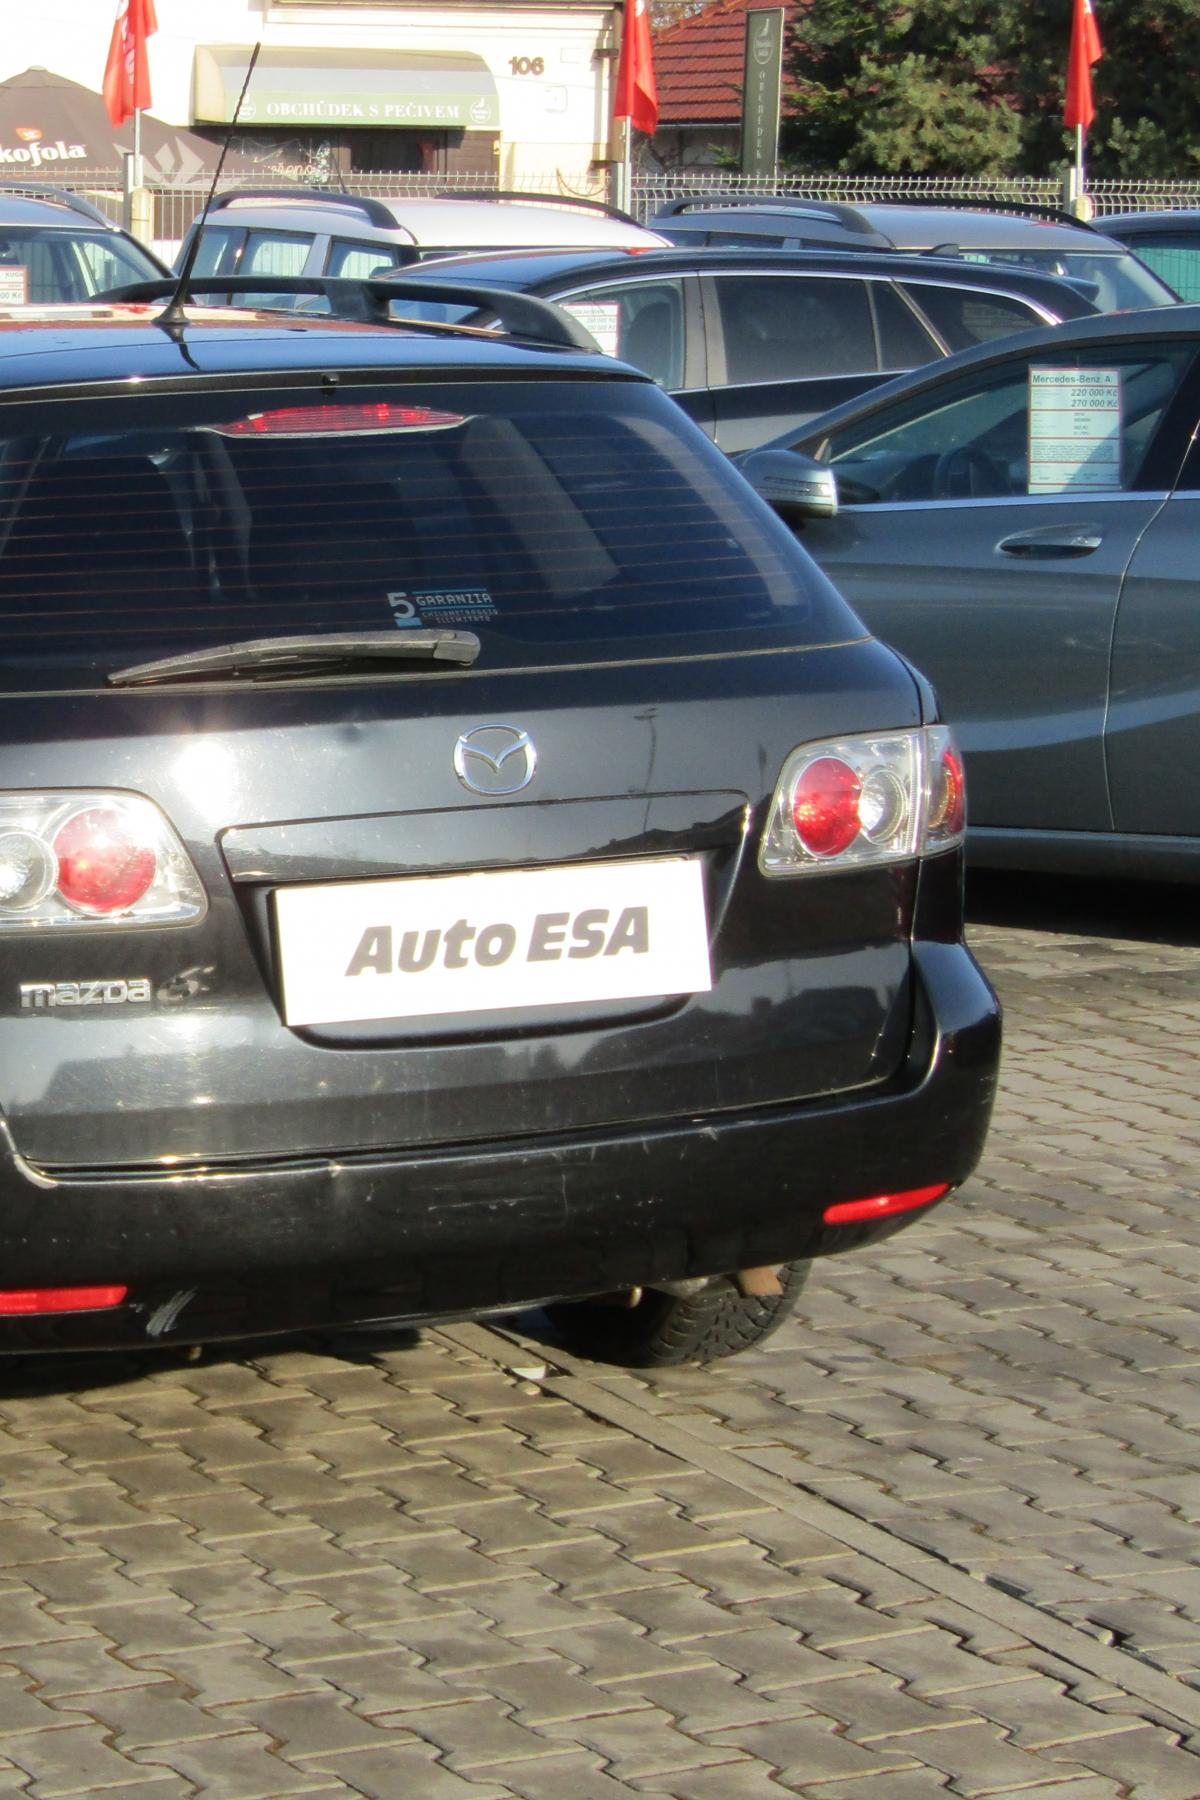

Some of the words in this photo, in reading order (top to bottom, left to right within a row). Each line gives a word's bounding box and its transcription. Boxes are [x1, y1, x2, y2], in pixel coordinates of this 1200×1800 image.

[508, 56, 544, 76] 106
[266, 100, 365, 118] OBCHŮDEK
[369, 103, 379, 118] S
[384, 102, 460, 119] PEČIVEM
[1032, 375, 1101, 384] Mercedes-Benz
[1071, 388, 1087, 397] 220
[1089, 388, 1104, 397] 000
[1106, 388, 1118, 397] Kč
[1071, 399, 1087, 408] 270
[1089, 399, 1105, 408] 000
[1106, 399, 1118, 408] Kč
[386, 591, 416, 619] 5
[415, 592, 493, 606] GARANZIA
[345, 918, 517, 977] Auto
[526, 906, 649, 963] ESA
